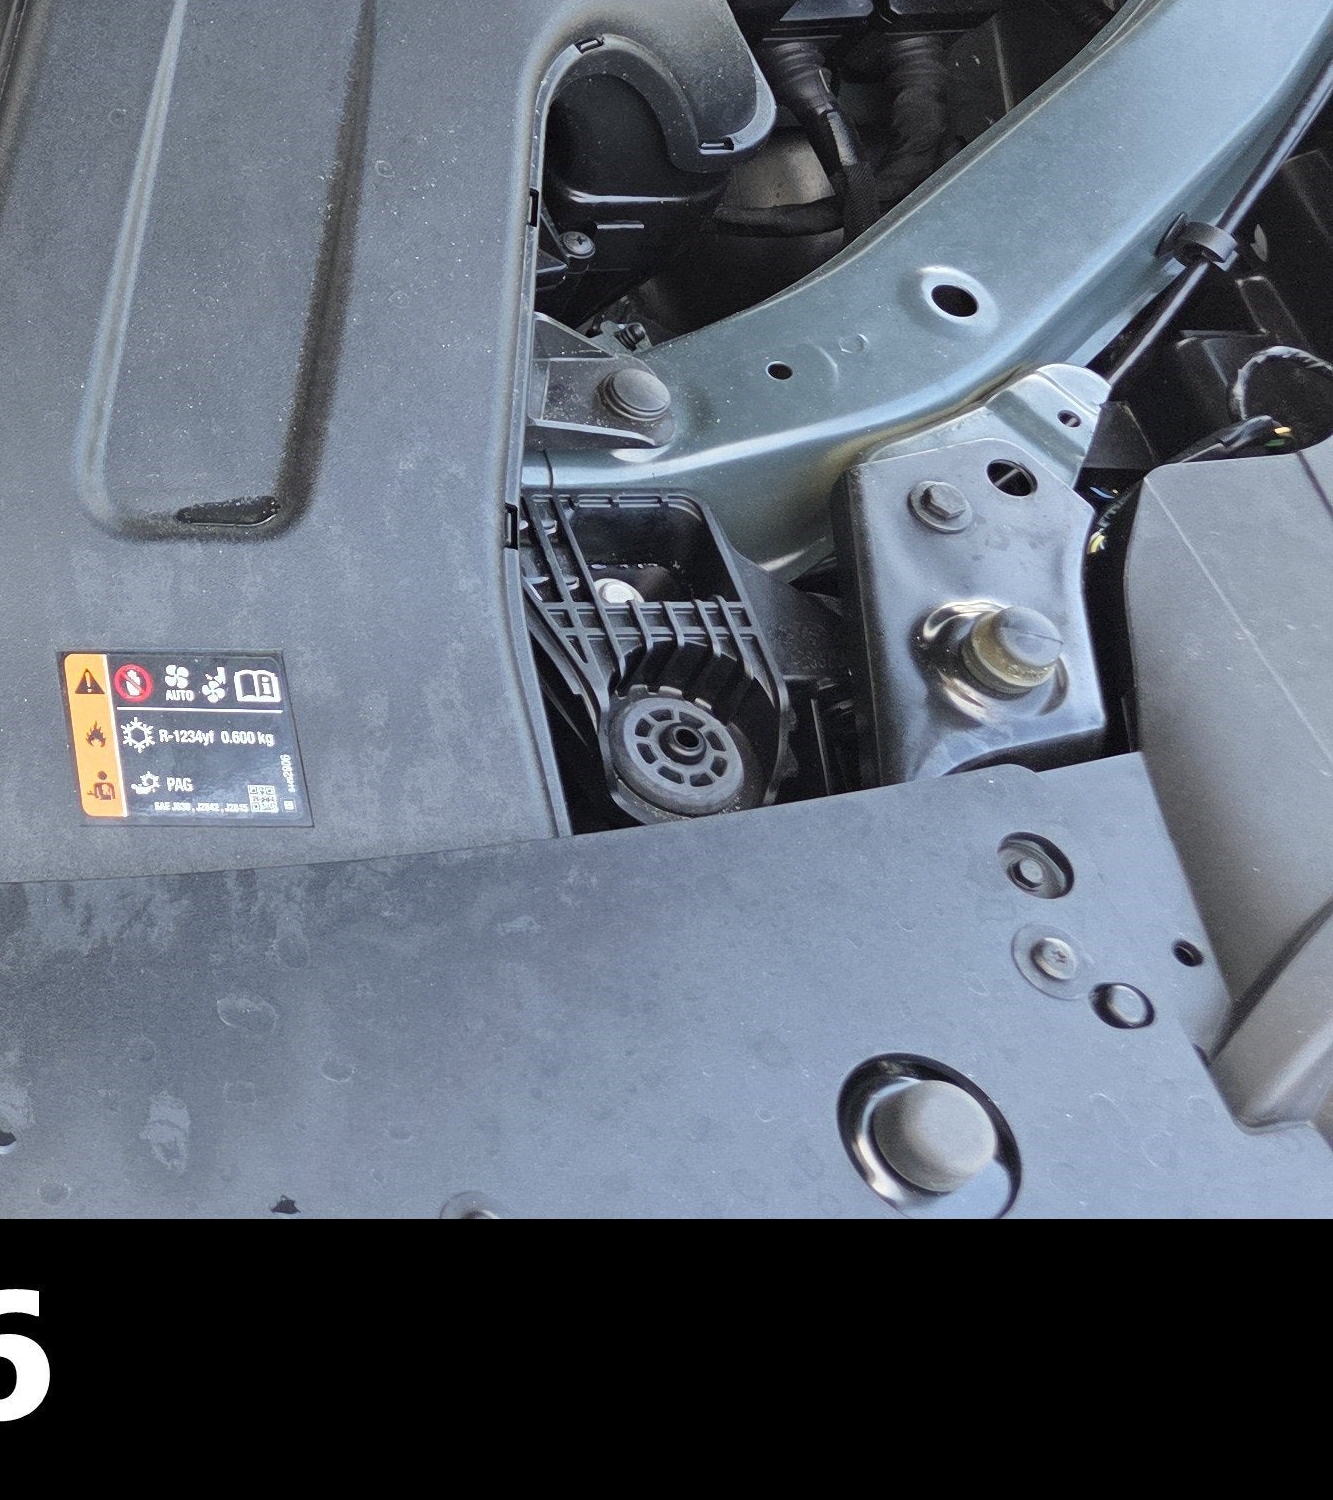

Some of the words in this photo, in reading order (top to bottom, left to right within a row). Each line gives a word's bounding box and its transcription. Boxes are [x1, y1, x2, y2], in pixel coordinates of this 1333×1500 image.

[165, 689, 194, 701] AUTO
[159, 730, 215, 746] R-1234yf
[221, 730, 255, 743] 0.600
[257, 731, 275, 747] kg
[166, 777, 193, 791] PAG
